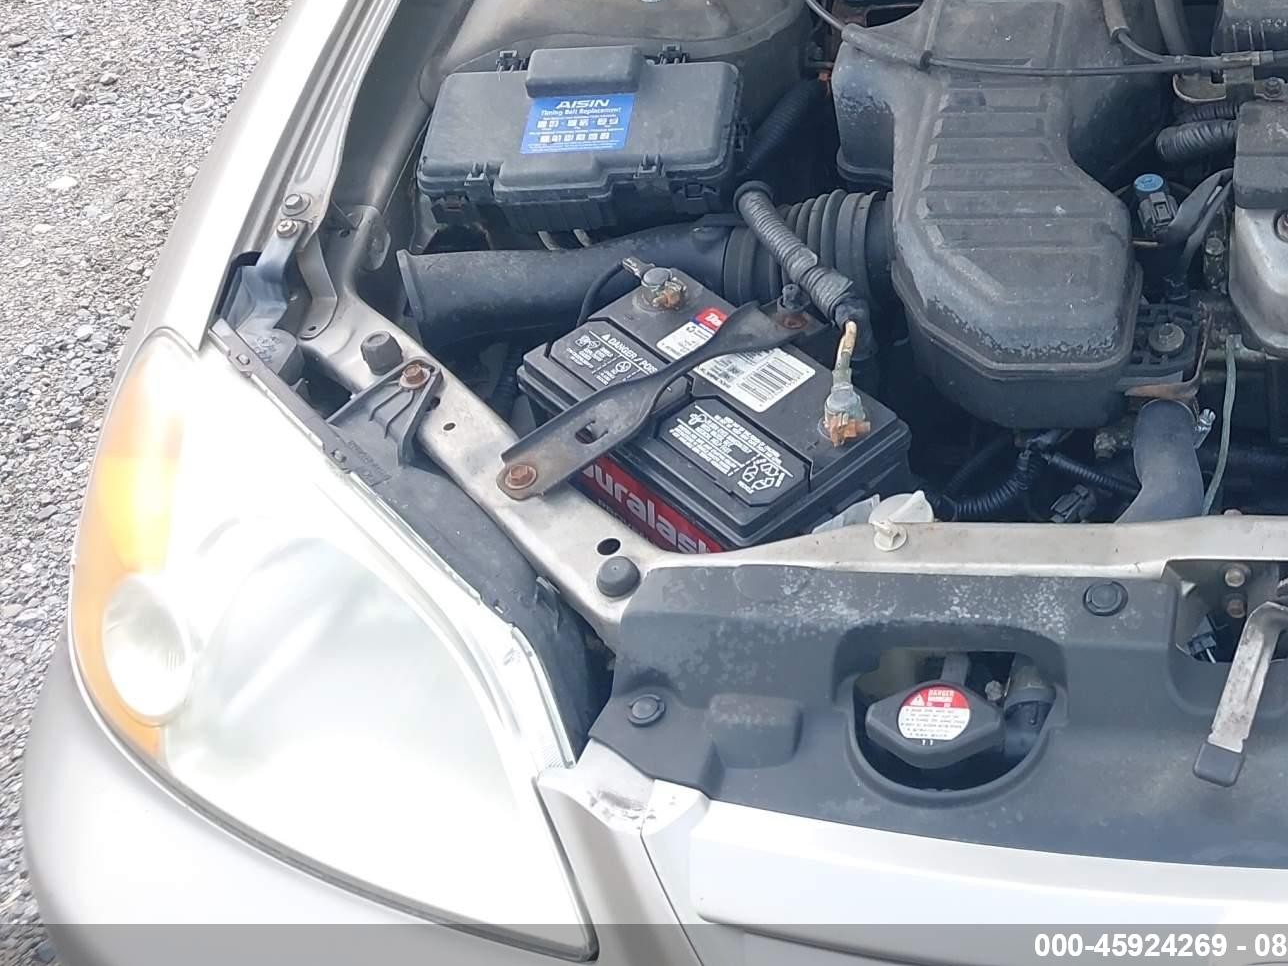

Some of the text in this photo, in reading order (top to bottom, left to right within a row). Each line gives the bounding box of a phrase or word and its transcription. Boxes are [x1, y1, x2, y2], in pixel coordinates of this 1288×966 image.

[555, 99, 610, 109] AISIN
[579, 107, 622, 115] Replacement
[607, 337, 638, 360] DANGER
